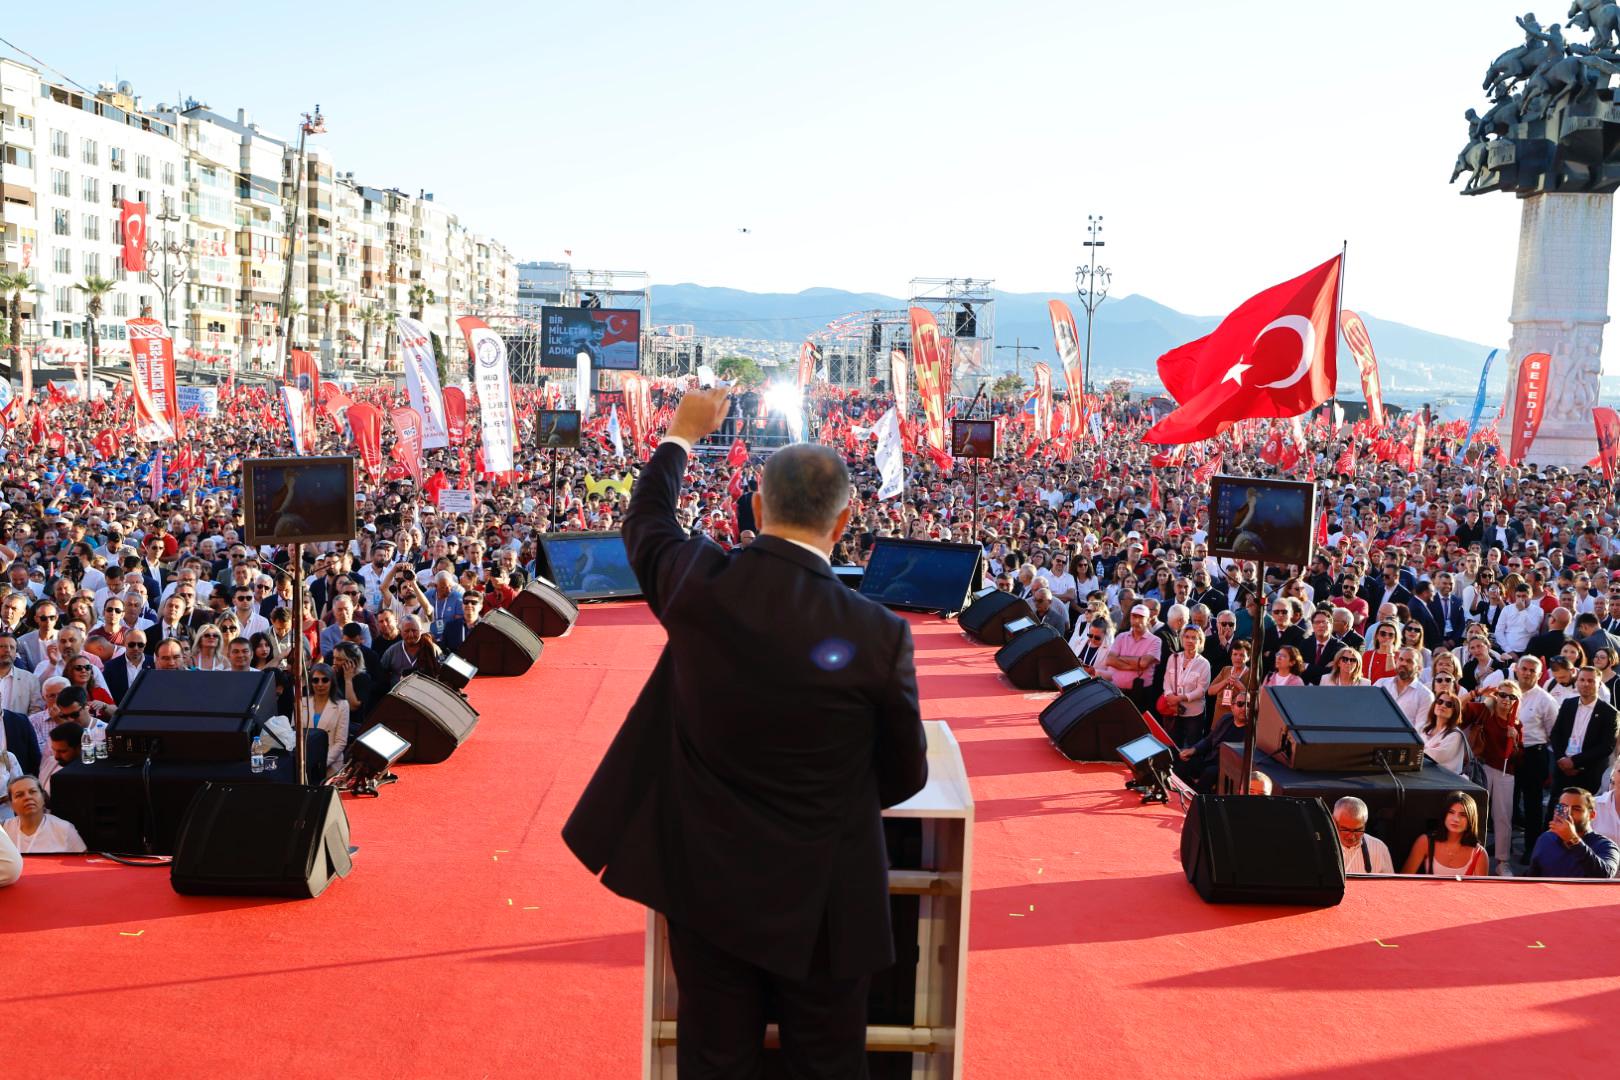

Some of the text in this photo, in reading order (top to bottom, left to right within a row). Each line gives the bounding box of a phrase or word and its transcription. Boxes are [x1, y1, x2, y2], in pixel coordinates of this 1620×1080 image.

[549, 314, 563, 324] BİR
[549, 336, 562, 345] İLK
[549, 346, 575, 355] ADIMI
